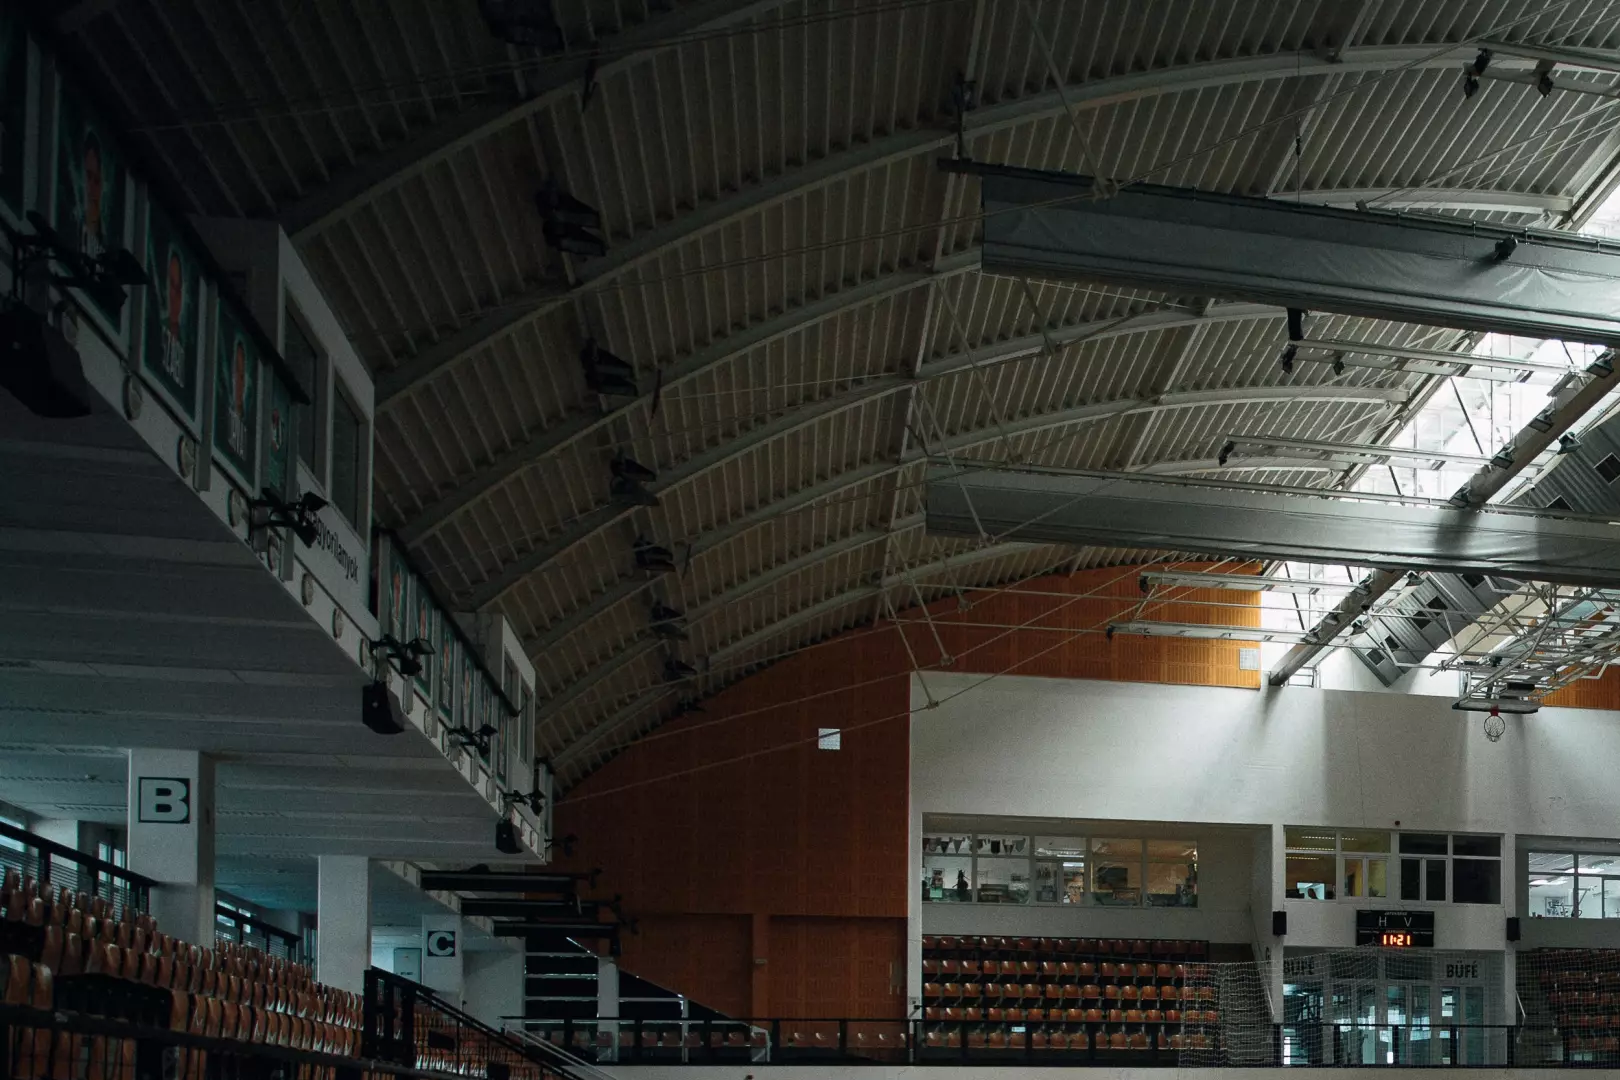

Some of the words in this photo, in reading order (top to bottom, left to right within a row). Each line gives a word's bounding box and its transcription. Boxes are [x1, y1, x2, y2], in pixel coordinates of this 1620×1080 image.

[140, 779, 189, 822] B
[1404, 916, 1412, 927] V
[428, 931, 455, 956] C
[1446, 960, 1478, 978] BÜFÉ
